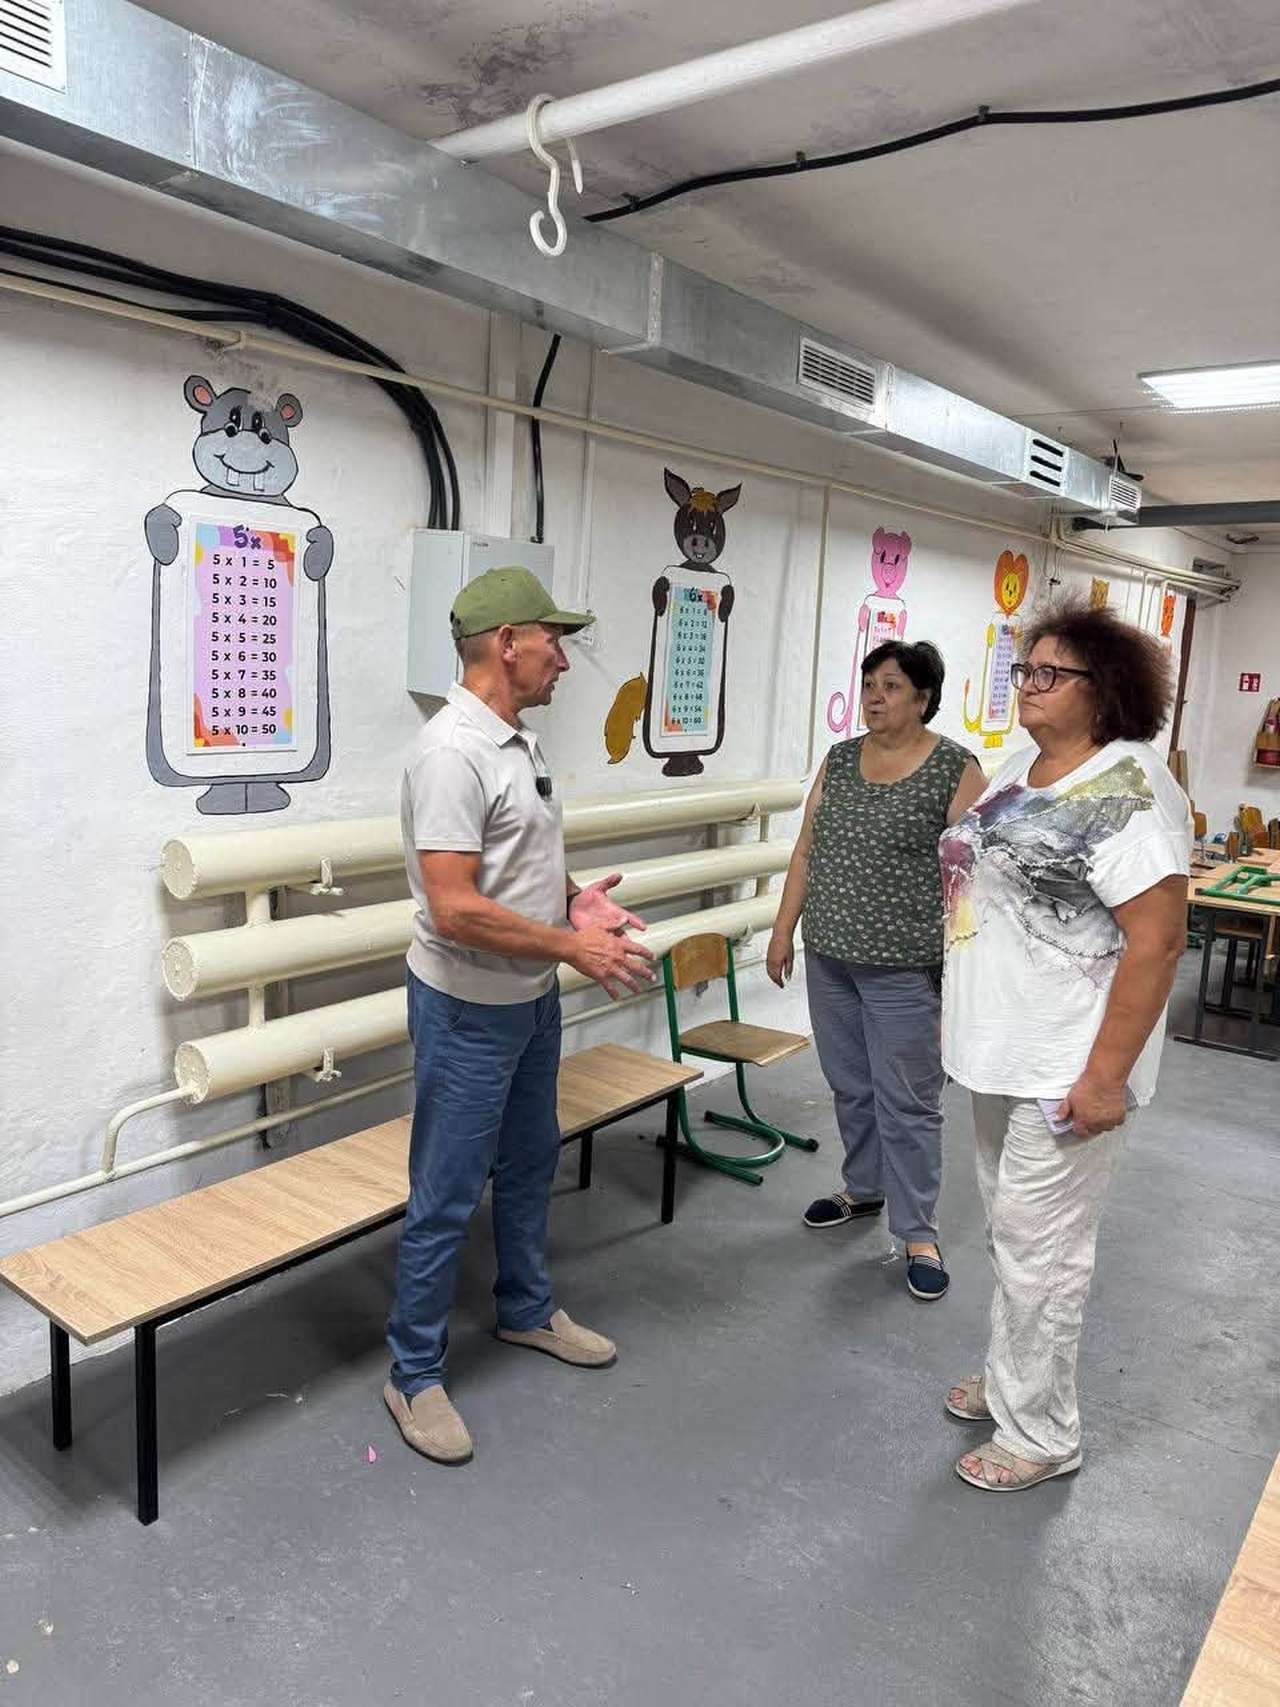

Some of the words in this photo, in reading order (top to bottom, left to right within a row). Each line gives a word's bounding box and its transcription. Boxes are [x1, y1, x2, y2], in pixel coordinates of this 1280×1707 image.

[233, 524, 261, 550] 5x
[213, 554, 220, 565] 5
[225, 557, 232, 566] x
[267, 559, 275, 570] 5
[212, 573, 220, 584] 5
[225, 576, 232, 586] x
[240, 576, 247, 587] 2
[264, 578, 277, 589] 10
[212, 592, 220, 604] 5
[224, 596, 232, 605] x
[239, 594, 246, 606] 3
[263, 596, 276, 608] 15
[689, 587, 703, 602] 6x
[212, 612, 219, 623] 5
[224, 614, 231, 624] x
[238, 613, 247, 624] 4
[262, 615, 277, 626] 20
[211, 631, 219, 642] 5
[224, 634, 231, 643] x
[238, 632, 246, 643] 5
[262, 633, 276, 644] 25
[211, 650, 219, 661] 5
[224, 652, 231, 661] x
[238, 651, 246, 662] 6
[262, 652, 276, 662] 30
[211, 669, 219, 680] 5
[223, 672, 231, 680] x
[238, 669, 246, 680] 7
[262, 670, 276, 680] 35
[211, 688, 219, 699] 5
[224, 690, 231, 699] x
[238, 688, 246, 698] 8
[261, 688, 277, 698] 40
[212, 706, 219, 717] 5
[224, 708, 231, 717] x
[238, 706, 246, 717] 9
[262, 706, 276, 716] 45
[212, 725, 219, 736] 5
[224, 727, 231, 735] x
[236, 724, 248, 735] 10
[262, 724, 276, 734] 50
